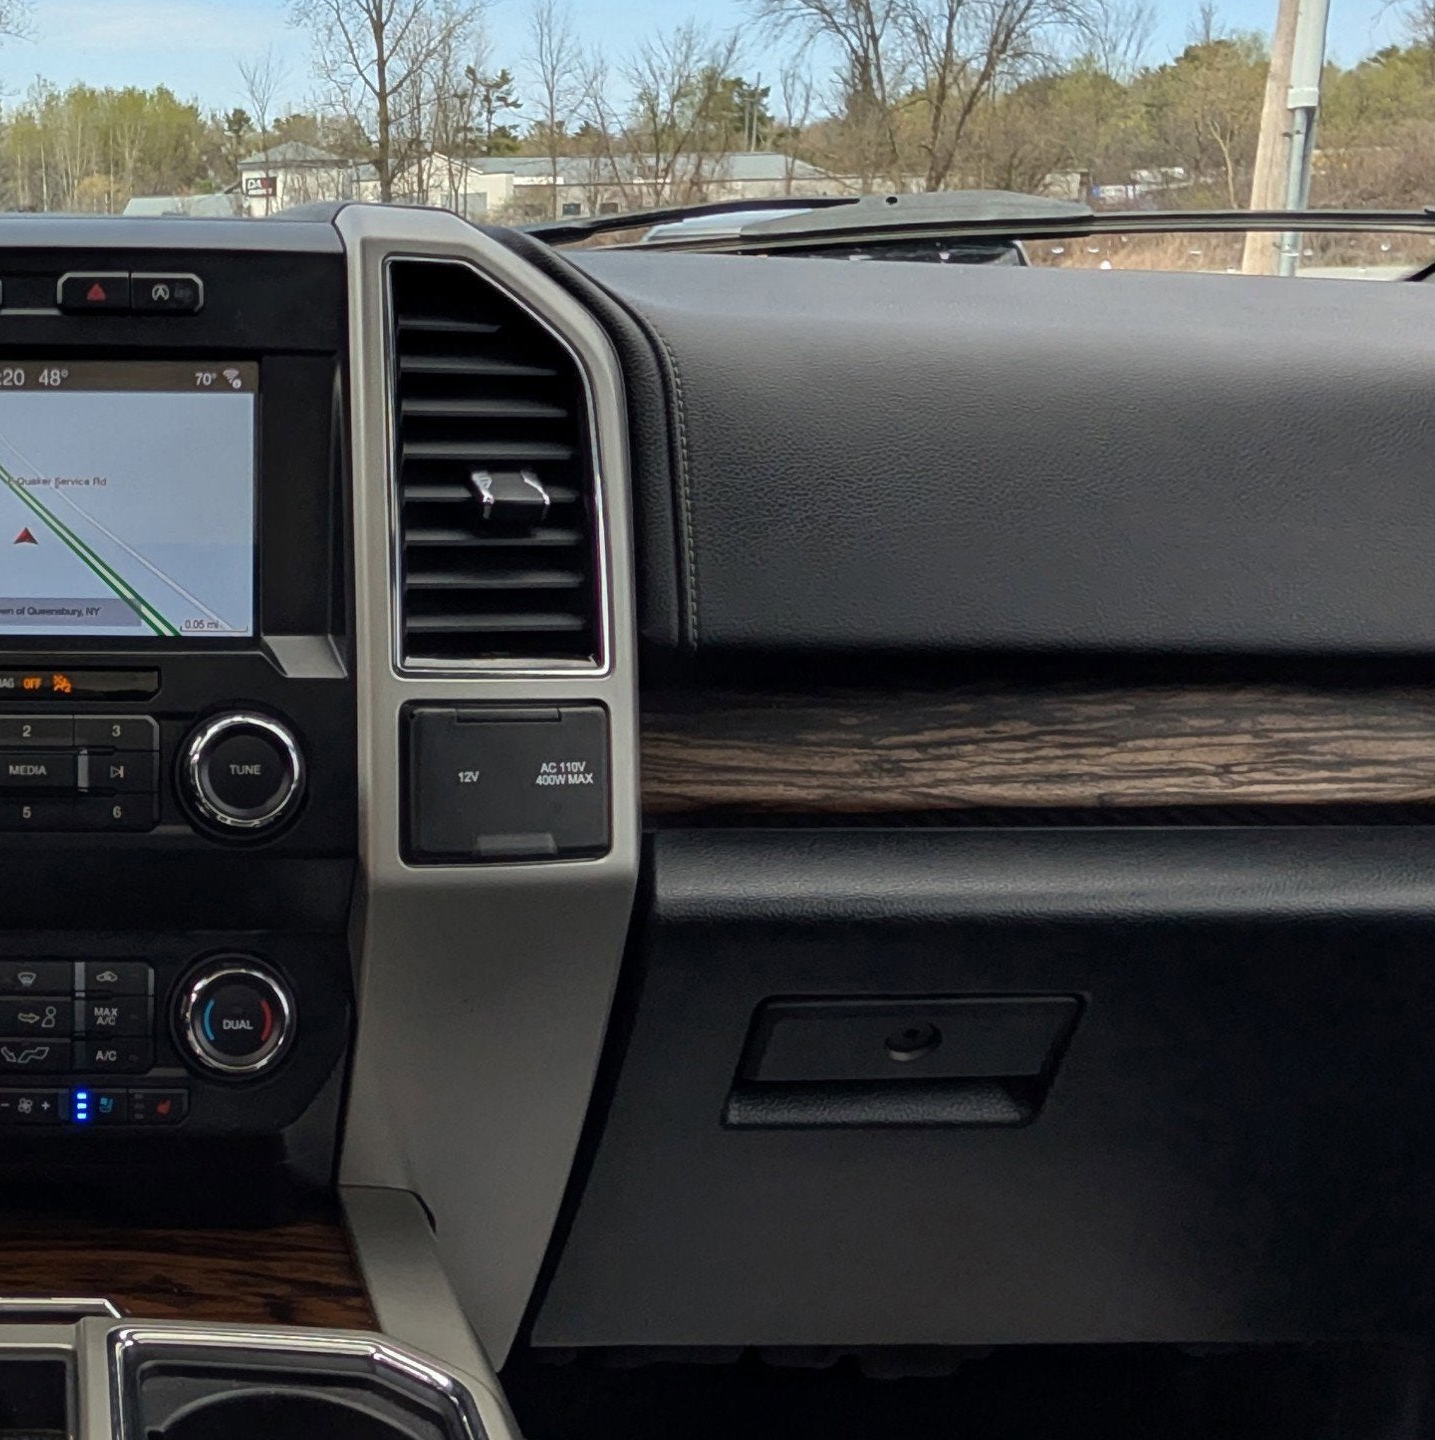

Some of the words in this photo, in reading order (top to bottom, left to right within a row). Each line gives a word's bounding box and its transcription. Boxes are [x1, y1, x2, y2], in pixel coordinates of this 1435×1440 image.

[86, 607, 102, 616] NY
[23, 678, 43, 689] OFF
[22, 725, 31, 737] 2
[112, 725, 121, 737] 3
[9, 764, 47, 776] MEDIA
[229, 764, 262, 775] TUNE
[540, 762, 557, 774] AC
[559, 761, 586, 773] 110V
[458, 771, 480, 783] 12V
[536, 774, 566, 786] 400W
[568, 772, 593, 785] MAX
[22, 806, 31, 818] 5
[113, 806, 122, 818] 6
[94, 1007, 118, 1017] MAX
[96, 1017, 116, 1026] A/C
[222, 1019, 253, 1030] DUAL
[95, 1051, 117, 1061] A/C
